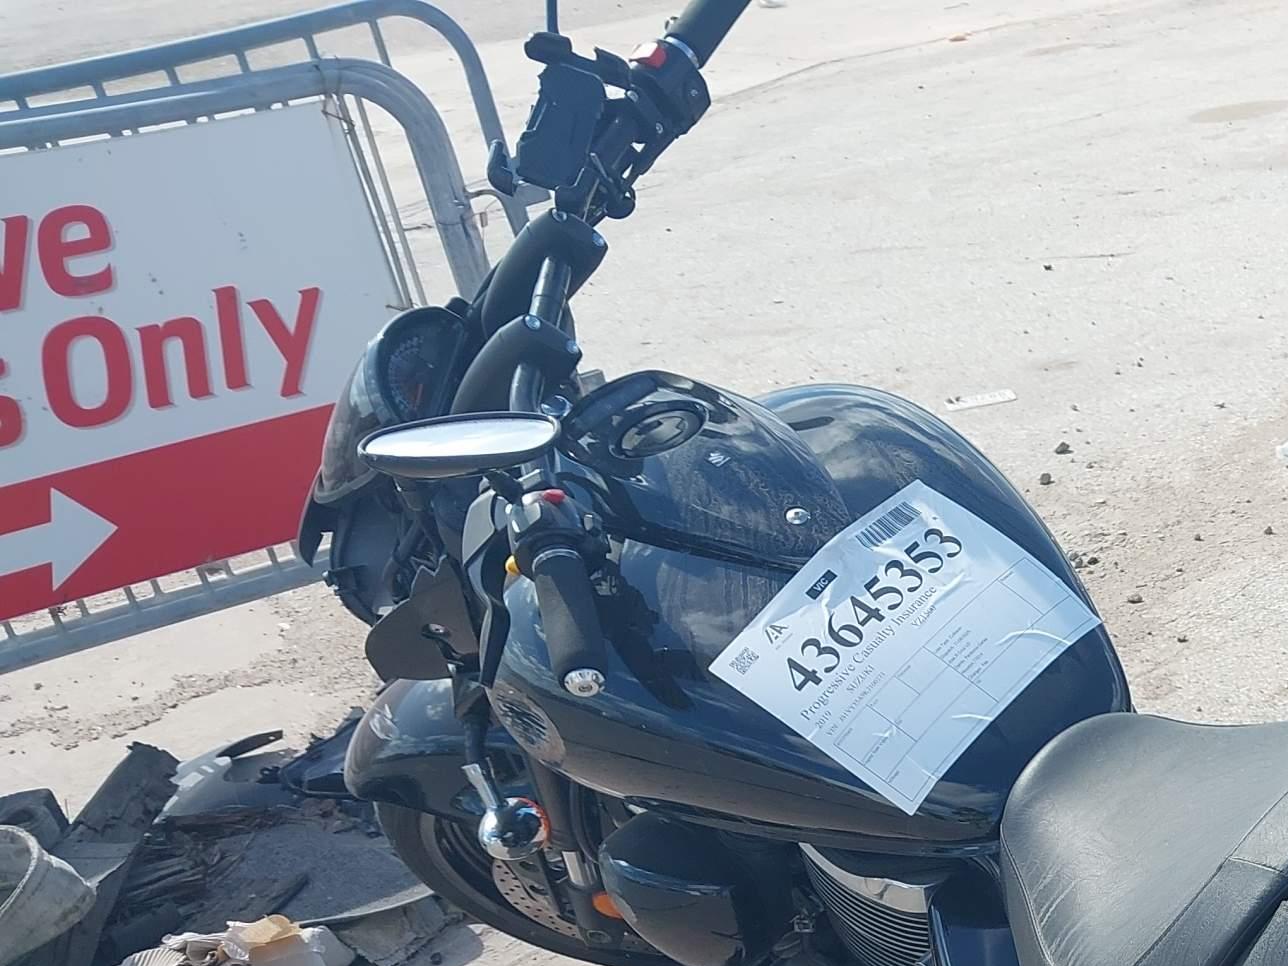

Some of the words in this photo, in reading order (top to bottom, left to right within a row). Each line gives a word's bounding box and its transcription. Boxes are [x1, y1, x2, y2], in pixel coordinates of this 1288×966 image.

[41, 285, 323, 430] Only
[786, 528, 963, 692] 43645353
[813, 577, 829, 593] VIC
[800, 663, 856, 721] Progressive
[852, 624, 896, 664] Casualty
[891, 586, 937, 627] Insurance
[815, 710, 833, 729] 2019
[846, 664, 877, 694] SUZUKI
